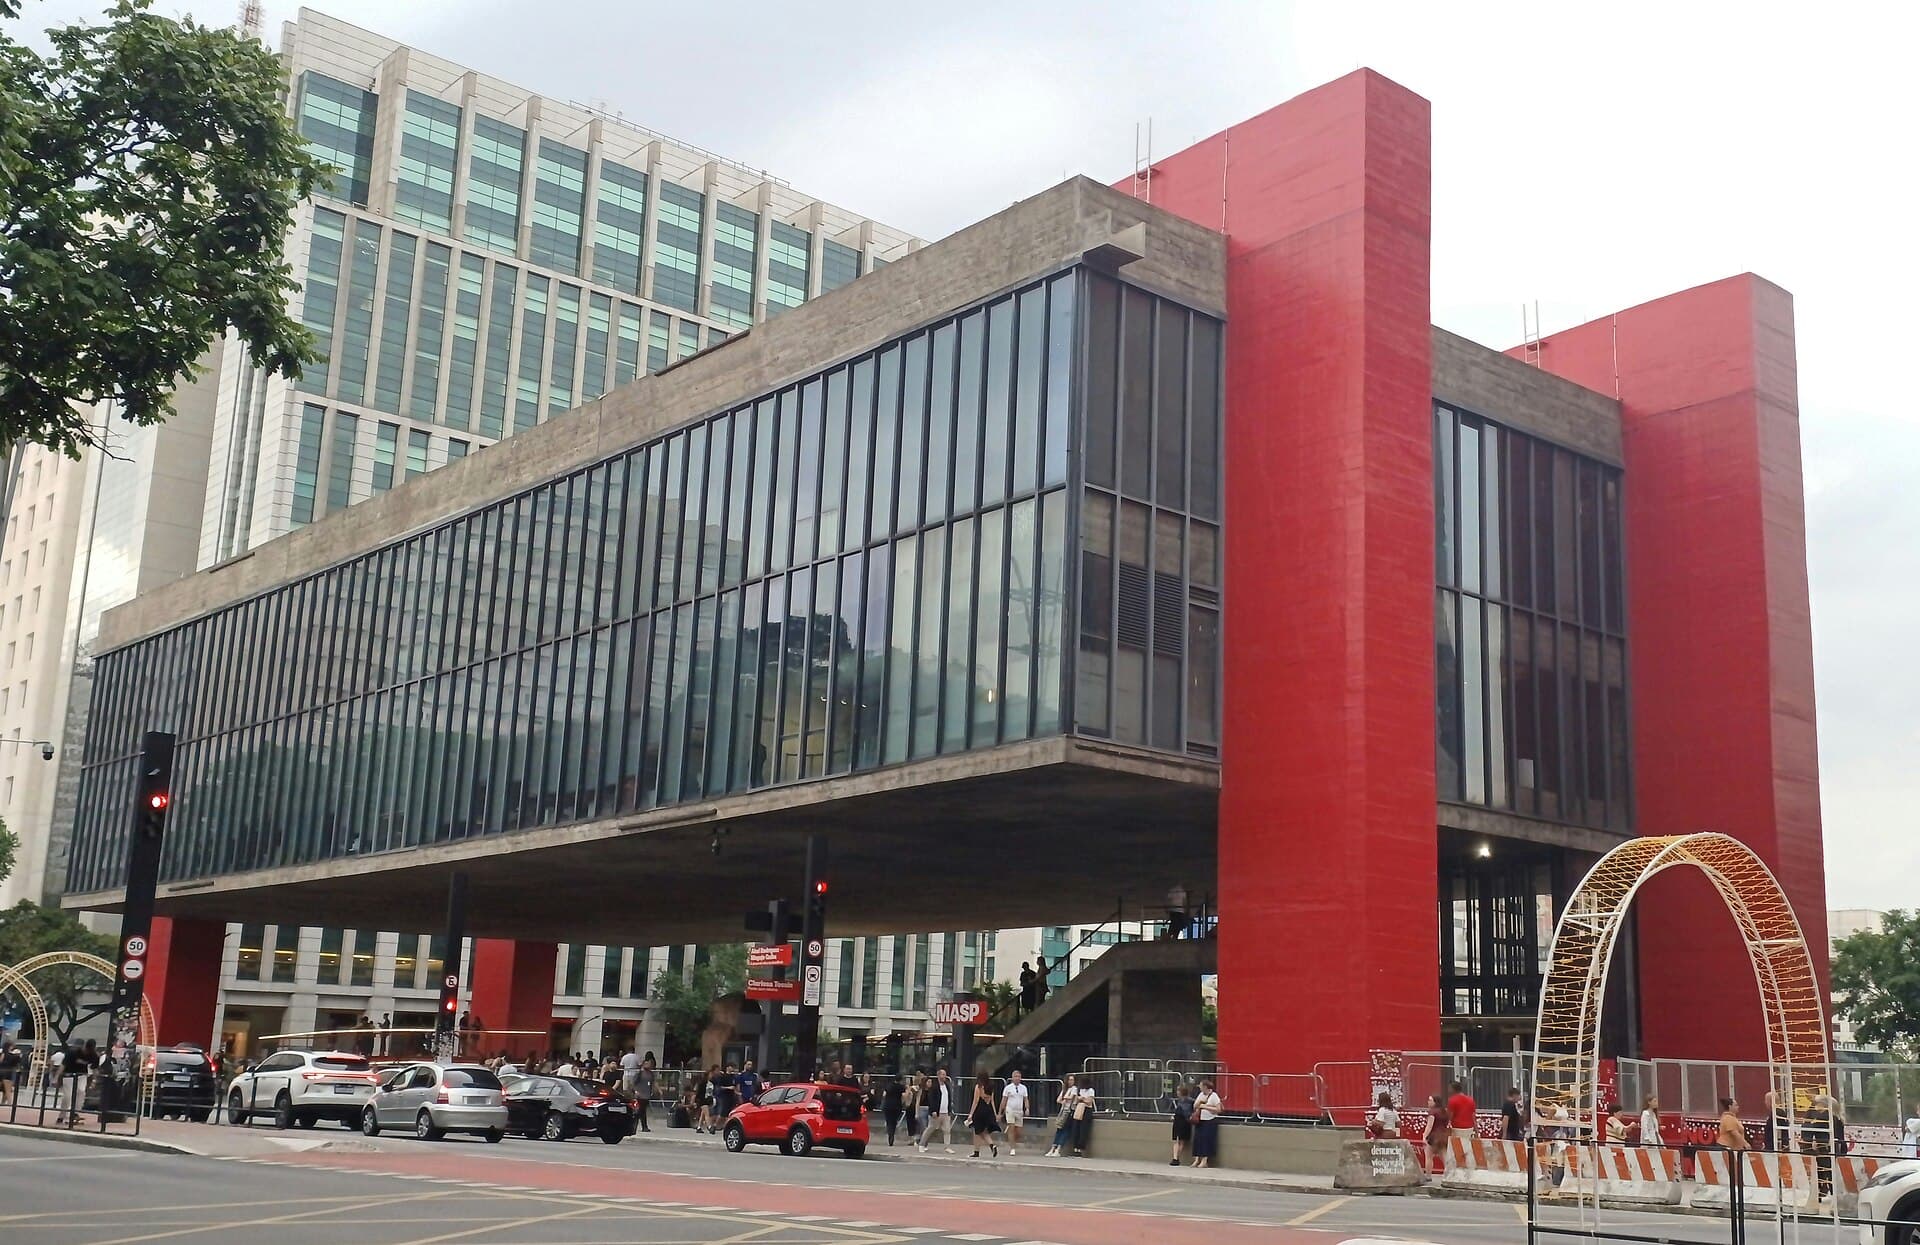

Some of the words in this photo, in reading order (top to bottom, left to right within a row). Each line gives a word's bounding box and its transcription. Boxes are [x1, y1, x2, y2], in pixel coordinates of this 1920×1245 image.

[129, 941, 143, 951] 50
[936, 1003, 979, 1022] MASP
[1371, 1144, 1402, 1155] denuncie
